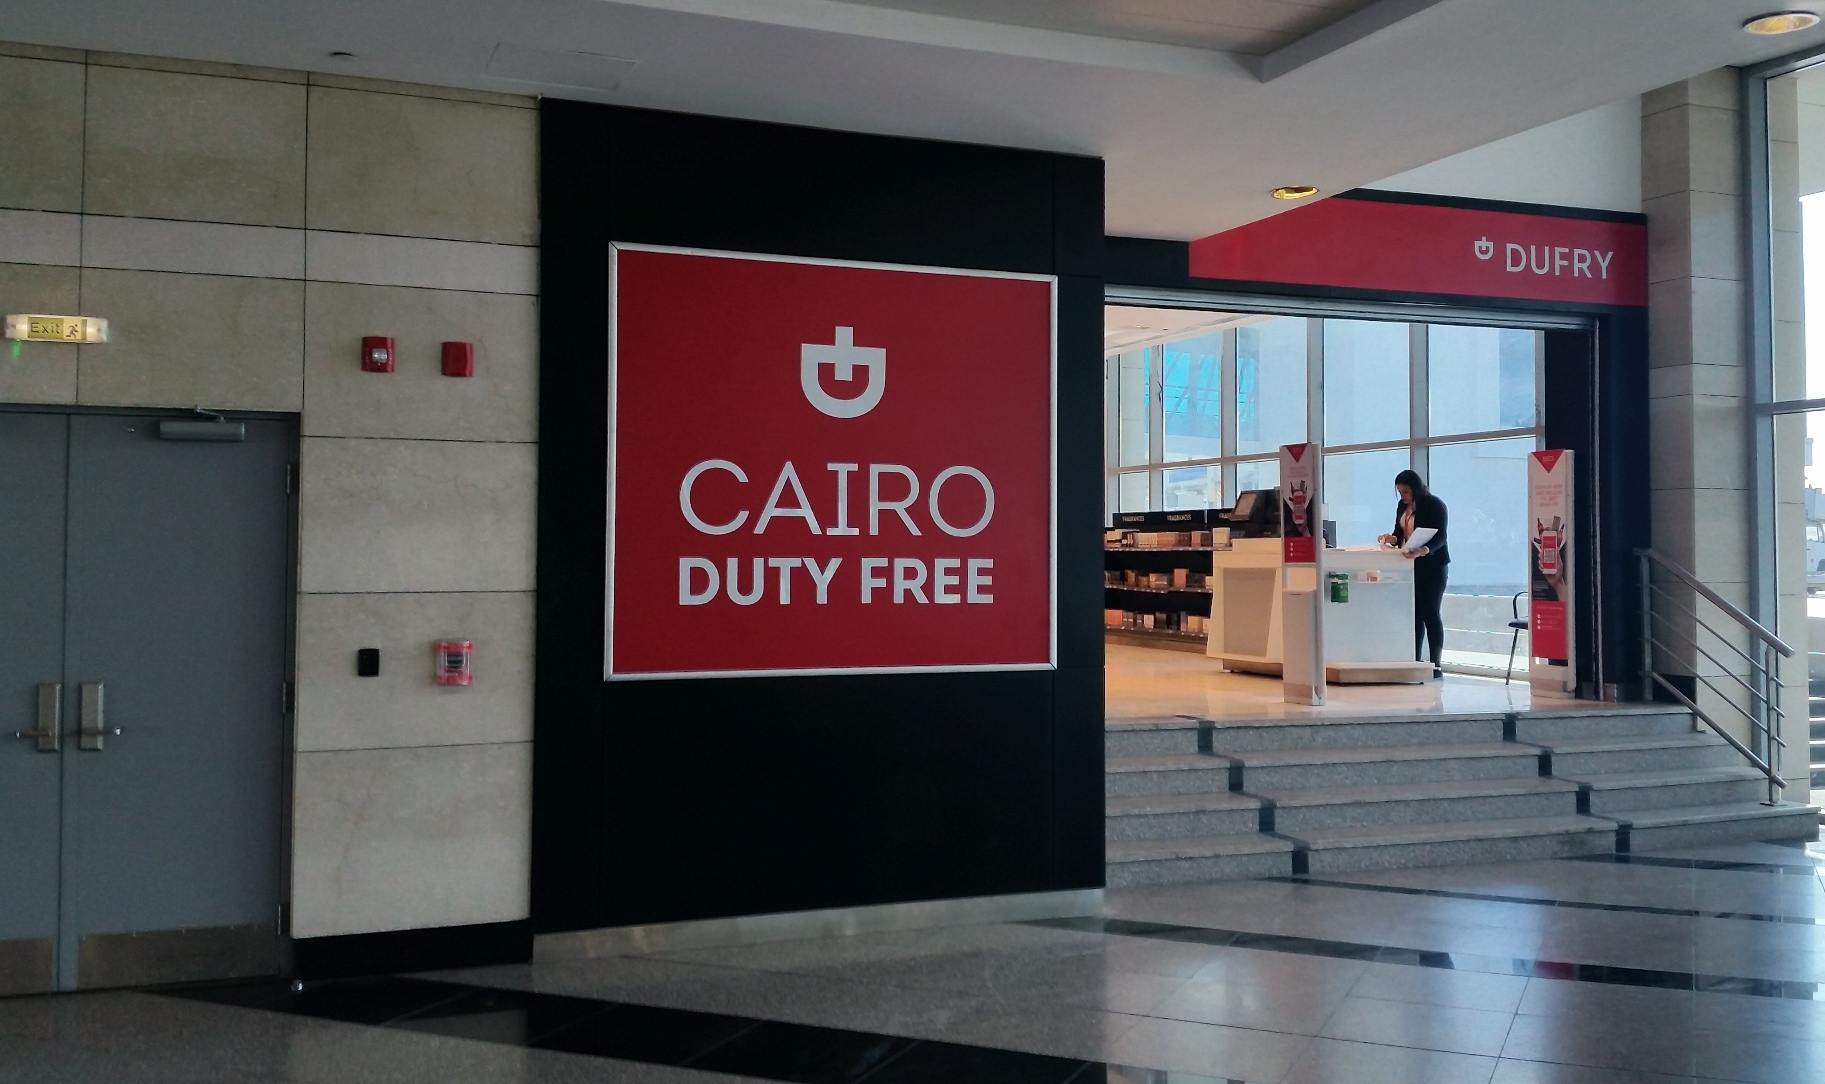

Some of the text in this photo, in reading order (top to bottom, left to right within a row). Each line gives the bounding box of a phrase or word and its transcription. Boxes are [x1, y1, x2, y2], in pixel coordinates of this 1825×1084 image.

[1506, 243, 1614, 279] DUFRY
[30, 322, 60, 334] Exit
[679, 459, 995, 537] CAIRO
[679, 557, 994, 606] DUTY FREE
